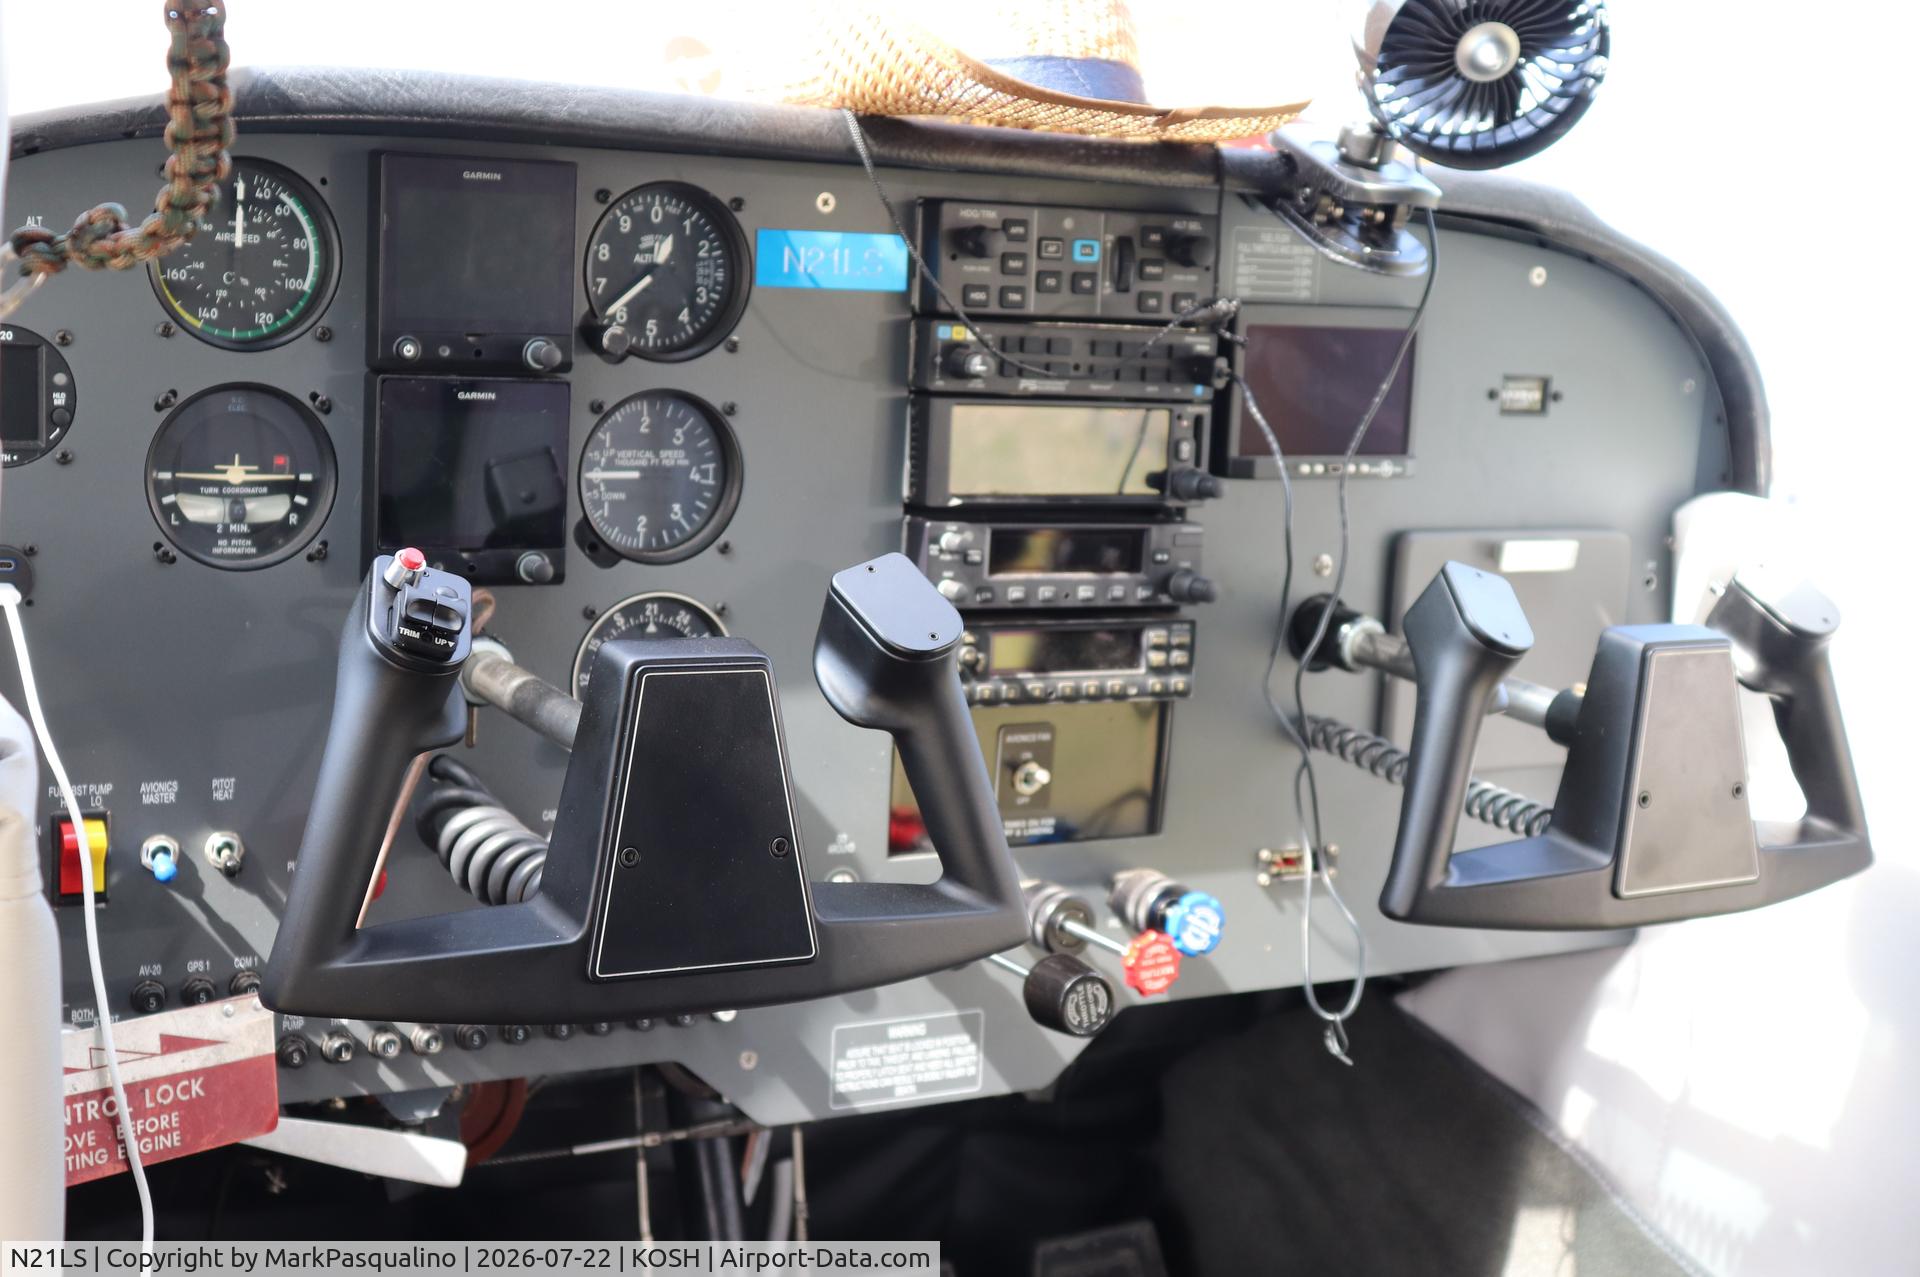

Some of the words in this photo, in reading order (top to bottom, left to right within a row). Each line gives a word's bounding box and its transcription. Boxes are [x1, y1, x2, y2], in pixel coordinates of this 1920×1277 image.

[463, 171, 501, 180] GARMIN
[255, 188, 271, 199] 40
[275, 204, 290, 216] 60
[651, 206, 662, 223] 0
[26, 216, 43, 227] ALT
[620, 216, 631, 232] 9
[683, 219, 691, 235] 1
[215, 232, 260, 244] AIRSEED
[293, 238, 307, 249] 80
[599, 243, 610, 260] 8
[698, 240, 709, 257] 2
[783, 246, 884, 276] N21LS
[167, 270, 187, 281] 160
[285, 279, 303, 290] 100
[596, 278, 607, 294] 7
[216, 289, 227, 297] 120
[696, 287, 707, 304] 3
[199, 307, 218, 319] 140
[255, 312, 274, 324] 120
[616, 307, 627, 323] 6
[678, 307, 690, 324] 4
[646, 320, 657, 336] 5
[458, 392, 496, 400] GARMIN
[640, 417, 650, 433] 2
[606, 432, 610, 447] 1
[673, 429, 684, 444] 3
[602, 448, 615, 456] UP
[617, 450, 655, 458] VERTICAL
[660, 450, 685, 458] SPEED
[690, 466, 701, 482] 4
[602, 492, 626, 500] DOWN
[604, 501, 608, 516] 1
[670, 504, 682, 520] 3
[171, 514, 180, 525] L
[289, 514, 298, 525] R
[637, 516, 647, 531] 2
[216, 524, 223, 533] 2
[230, 524, 250, 533] MIN.
[645, 603, 658, 616] 21
[676, 610, 691, 625] 24
[399, 626, 420, 639] TRIM
[434, 637, 447, 646] UP
[579, 674, 590, 687] 12
[140, 780, 178, 794] AVIONICS
[212, 778, 236, 790] PITOT
[48, 786, 64, 798] FUE
[89, 783, 113, 796] PUMP
[213, 788, 234, 800] HEAT
[90, 796, 102, 807] LO
[142, 792, 176, 804] MASTER
[188, 961, 204, 972] GPS
[234, 957, 252, 968] COM
[139, 965, 162, 976] AV-20
[149, 998, 156, 1008] 5
[200, 993, 206, 1003] 5
[72, 1008, 94, 1021] BOTH
[684, 1014, 690, 1024] 5
[283, 1020, 304, 1032] PUMP
[600, 1021, 608, 1032] 5
[643, 1017, 649, 1027] 5
[516, 1028, 524, 1040] 5
[561, 1024, 568, 1036] 5
[473, 1034, 480, 1045] 5
[292, 1052, 300, 1064] 5
[145, 1077, 204, 1108] LOCK
[118, 1133, 181, 1160] EGINE
